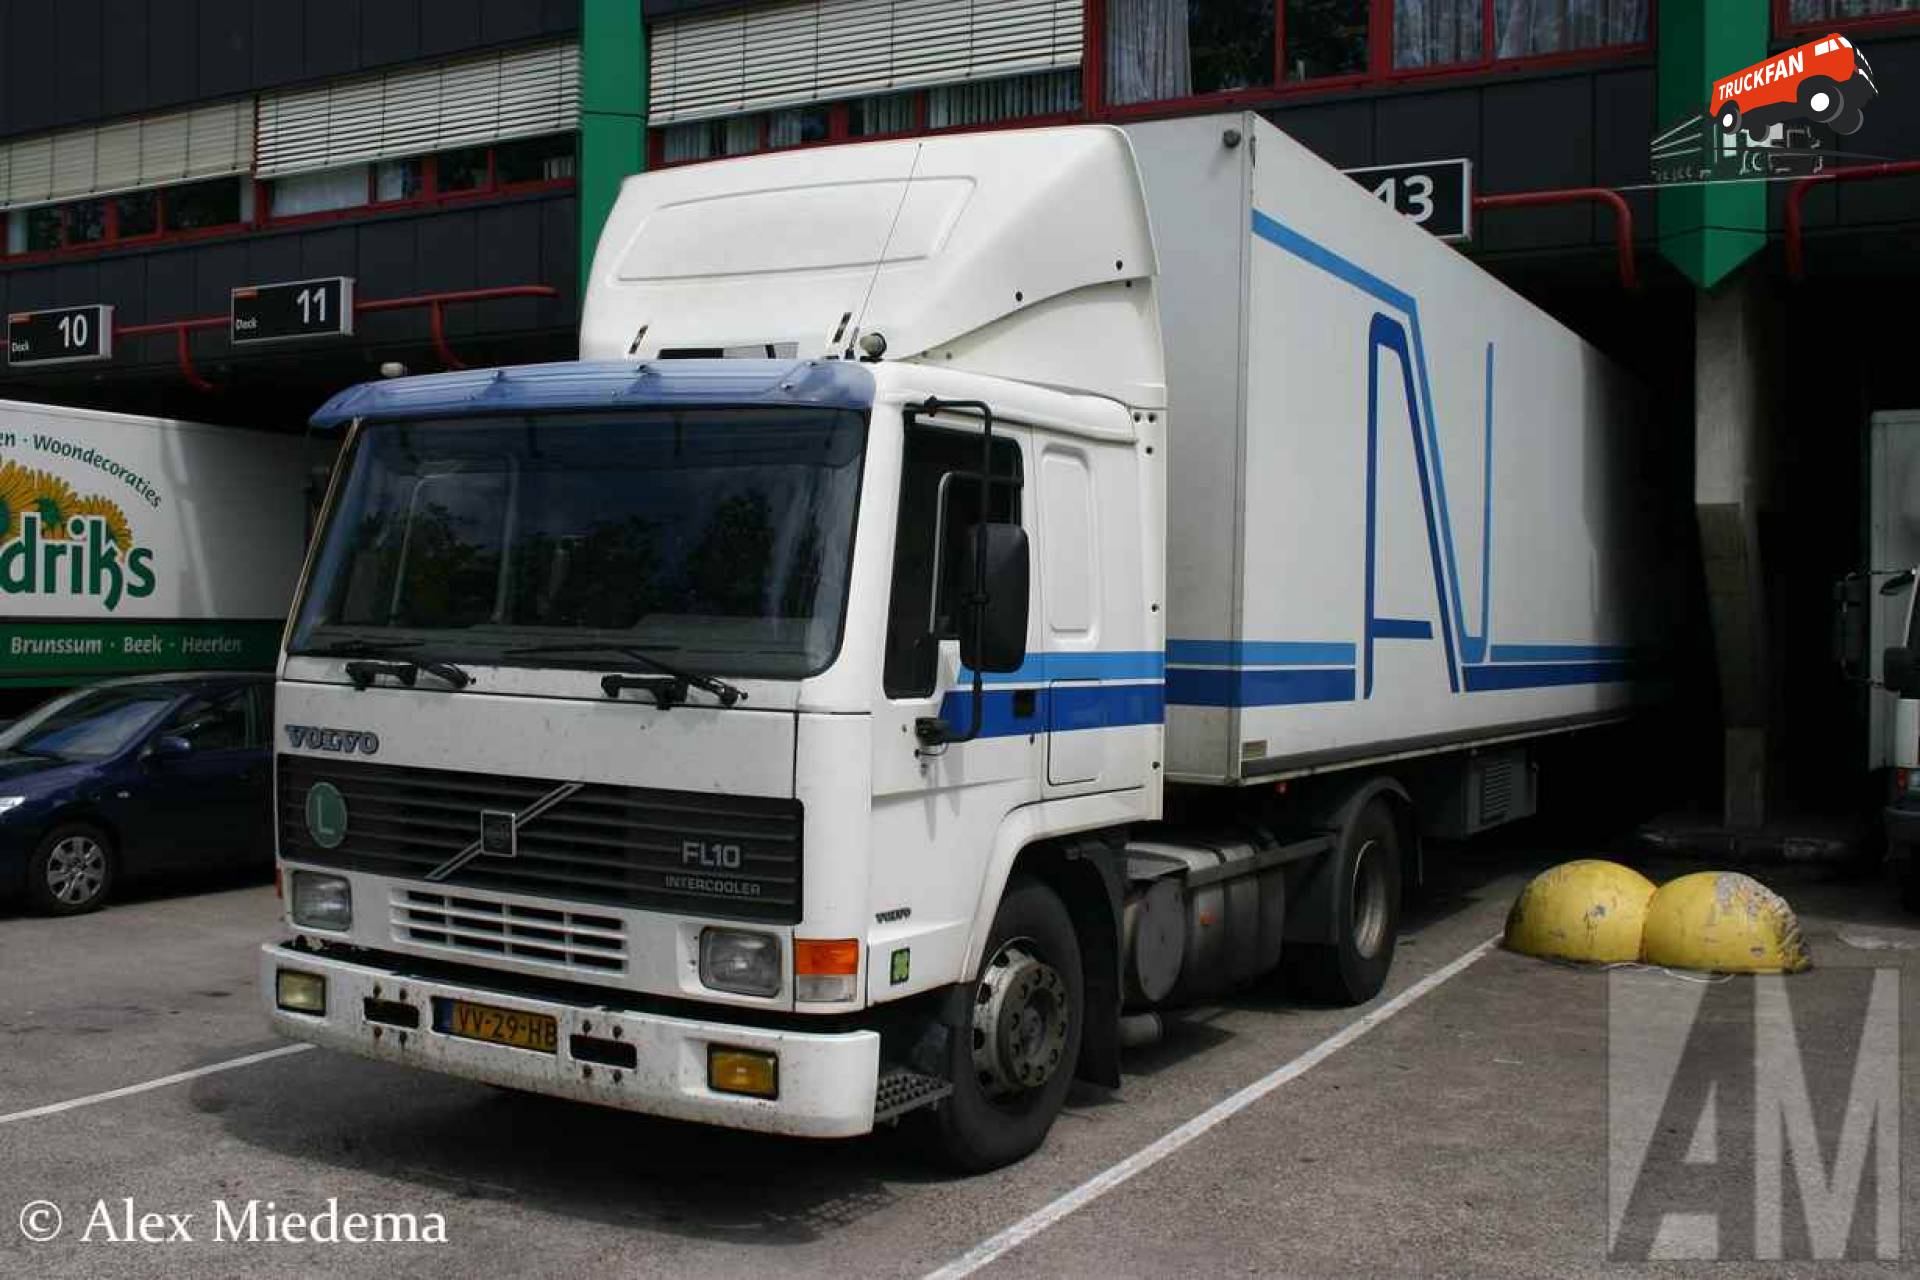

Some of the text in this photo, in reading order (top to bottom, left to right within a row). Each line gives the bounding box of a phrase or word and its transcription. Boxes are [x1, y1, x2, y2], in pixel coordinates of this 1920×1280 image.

[1373, 174, 1434, 223] 13
[296, 286, 326, 324] 11
[58, 314, 88, 348] 10
[32, 432, 162, 510] Woondecoraties
[11, 635, 242, 655] Brunssum Beek Heerlen
[285, 723, 380, 755] VOLVO
[317, 795, 333, 835] L
[682, 840, 741, 869] FL10
[665, 875, 761, 896] INTERCOOLER
[875, 906, 912, 924] VOLVO
[458, 1003, 558, 1047] VV-29-HB
